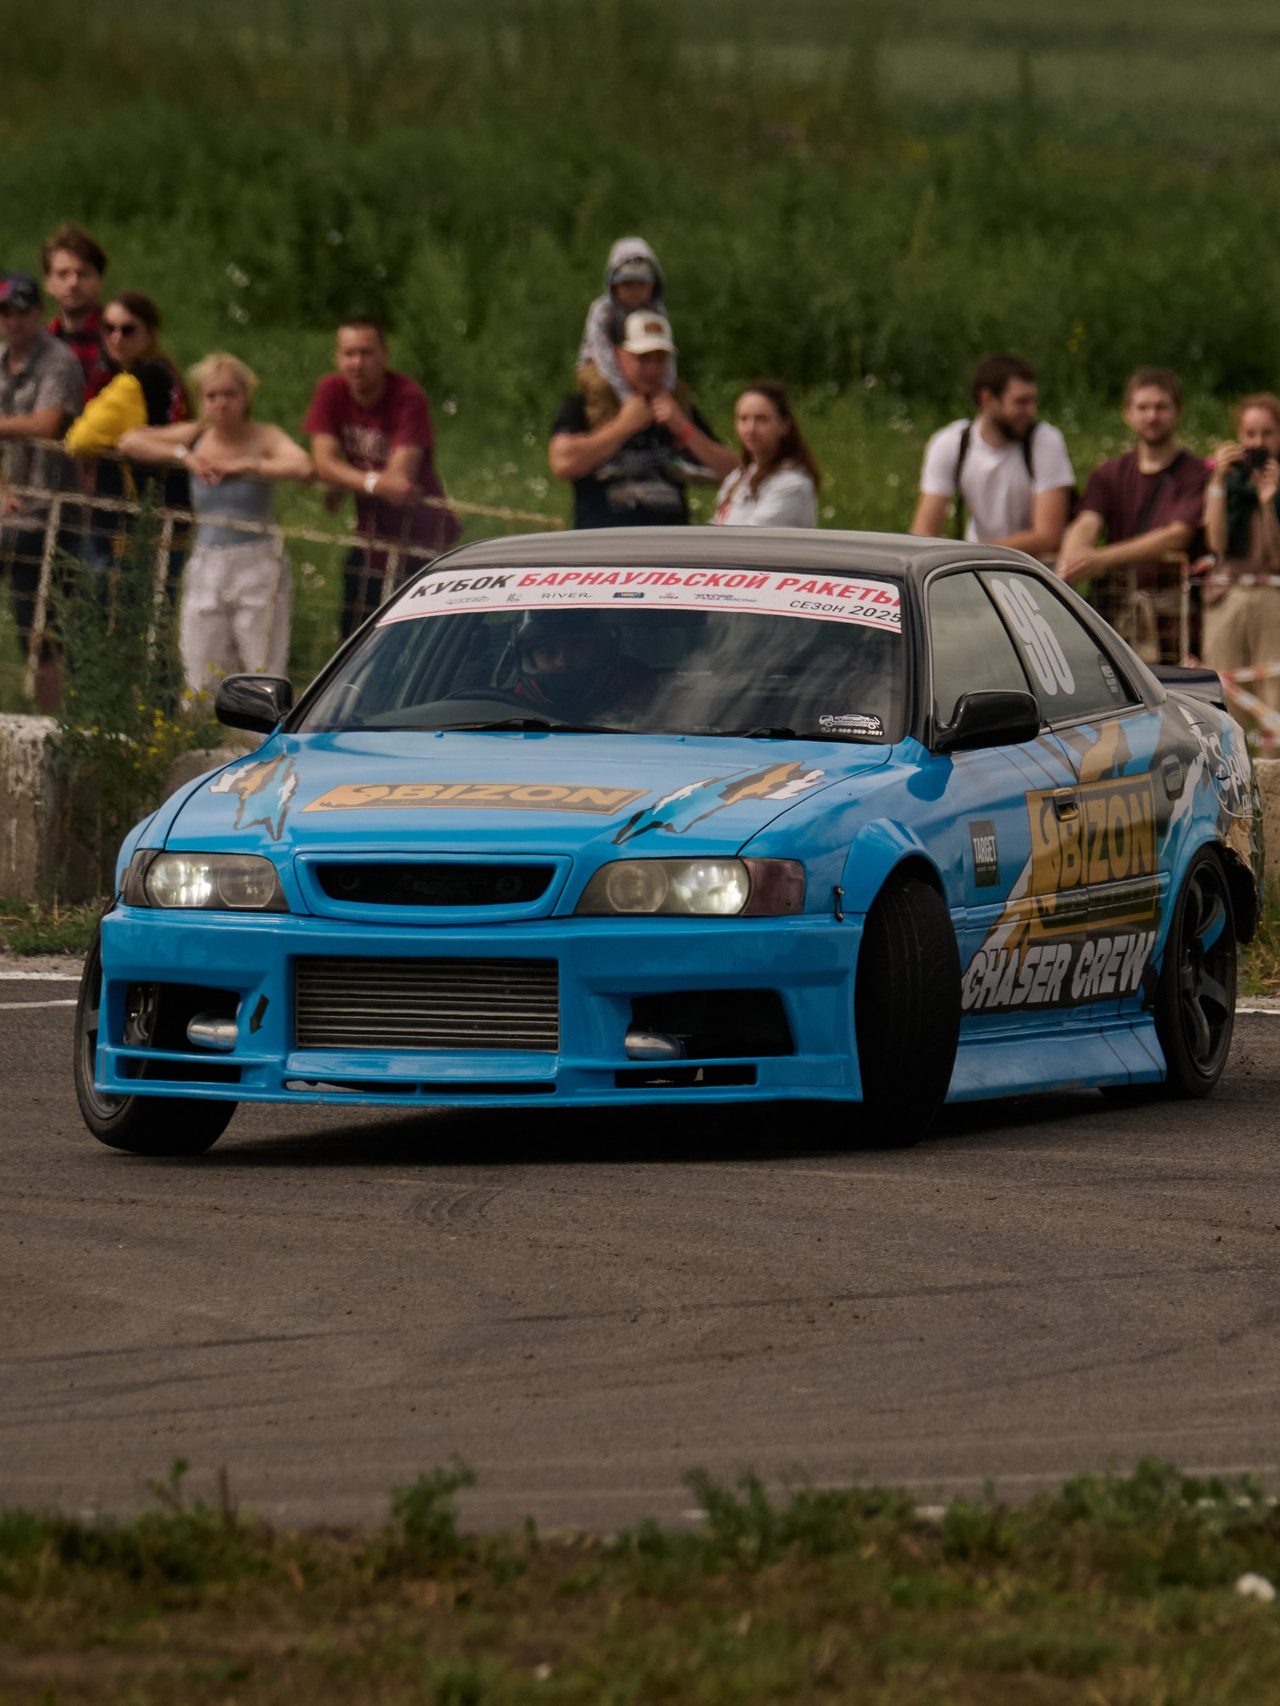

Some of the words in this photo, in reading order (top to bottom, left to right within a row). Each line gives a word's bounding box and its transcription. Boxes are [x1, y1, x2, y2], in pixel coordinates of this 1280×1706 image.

[410, 573, 517, 599] КУБОК
[516, 571, 771, 589] БАРНАУЛЬСКОЙ
[789, 600, 846, 614] СЕЗОН
[848, 605, 902, 623] 2025
[383, 784, 632, 805] BIZON
[972, 835, 997, 864] TARGET
[1059, 790, 1152, 889] BIZON
[961, 943, 1073, 1011] CHASER
[1071, 930, 1156, 1000] CREW
